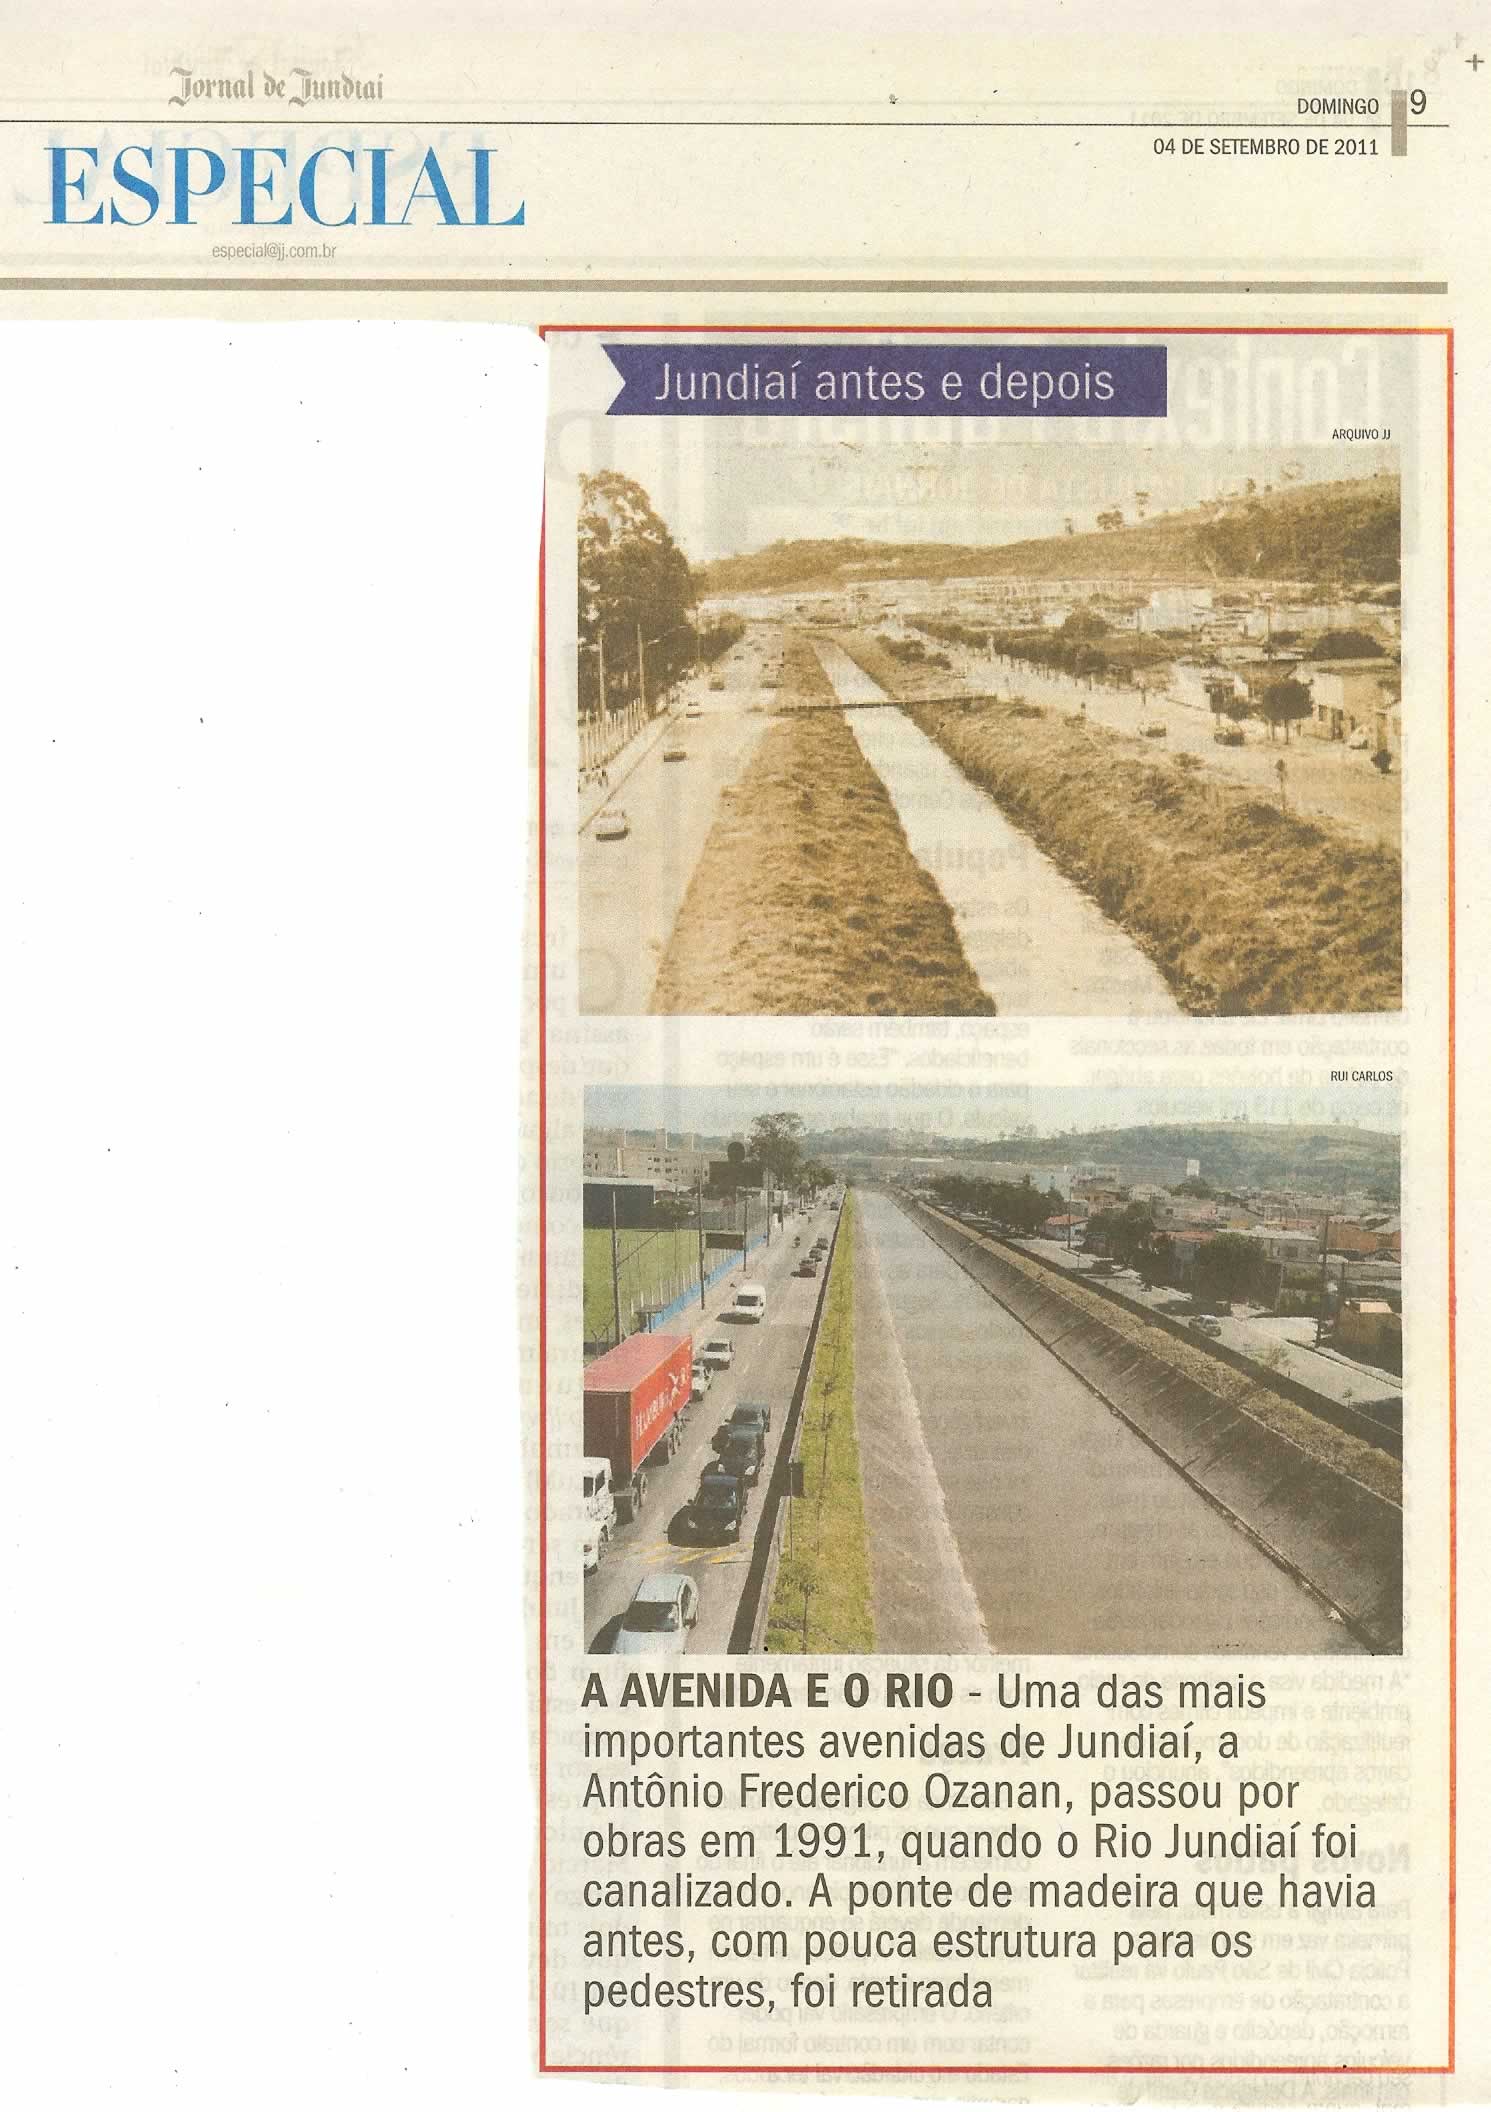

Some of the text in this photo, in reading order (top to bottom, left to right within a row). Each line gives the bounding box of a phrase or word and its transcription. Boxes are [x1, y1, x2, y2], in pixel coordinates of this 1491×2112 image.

[168, 67, 254, 107] Jornal
[263, 71, 286, 98] de
[1297, 97, 1379, 115] DOMINGO
[1410, 88, 1427, 115] 9
[1153, 138, 1379, 156] 04 DE SETEMBRO DE 2011
[44, 146, 526, 226] ESPECIAL
[212, 242, 337, 261] especial@jj.com.br
[655, 360, 1115, 410] Jundiaí antes e depois
[1332, 429, 1392, 441] ARQUIVO JJ
[1331, 1070, 1350, 1082] RUI
[1351, 1070, 1394, 1082] CARLOS
[580, 1672, 609, 1708] A
[619, 1672, 793, 1708] AVENIDA
[807, 1672, 829, 1708] E
[843, 1672, 870, 1708] O
[886, 1672, 953, 1709] RIO
[998, 1672, 1080, 1709] Uma
[1097, 1673, 1164, 1709] das
[1179, 1673, 1266, 1709] mais
[584, 1720, 1239, 1766] importantes avenidas de Jundiaí, a
[582, 1770, 1300, 1817] Antônio Frederico Ozanan, passou por
[583, 1822, 686, 1858] obras
[700, 1830, 755, 1858] em
[775, 1822, 885, 1864] 1991,
[901, 1823, 1042, 1866] quando
[1057, 1831, 1078, 1859] o
[1095, 1823, 1152, 1859] Rio
[1164, 1821, 1301, 1859] Jundiaí
[1311, 1822, 1356, 1859] foi
[583, 1872, 792, 1908] canalizado.
[808, 1872, 833, 1908] A
[849, 1875, 953, 1916] ponte
[968, 1872, 1013, 1908] de
[1029, 1872, 1178, 1909] madeira
[1195, 1880, 1263, 1916] que
[1280, 1872, 1376, 1909] havia
[583, 1925, 695, 1964] antes,
[711, 1930, 788, 1958] com
[805, 1930, 917, 1966] pouca
[933, 1925, 1096, 1958] estrutura
[1114, 1930, 1194, 1966] para
[1211, 1930, 1253, 1959] os
[584, 1971, 993, 2016] pedestres, foi retirada
